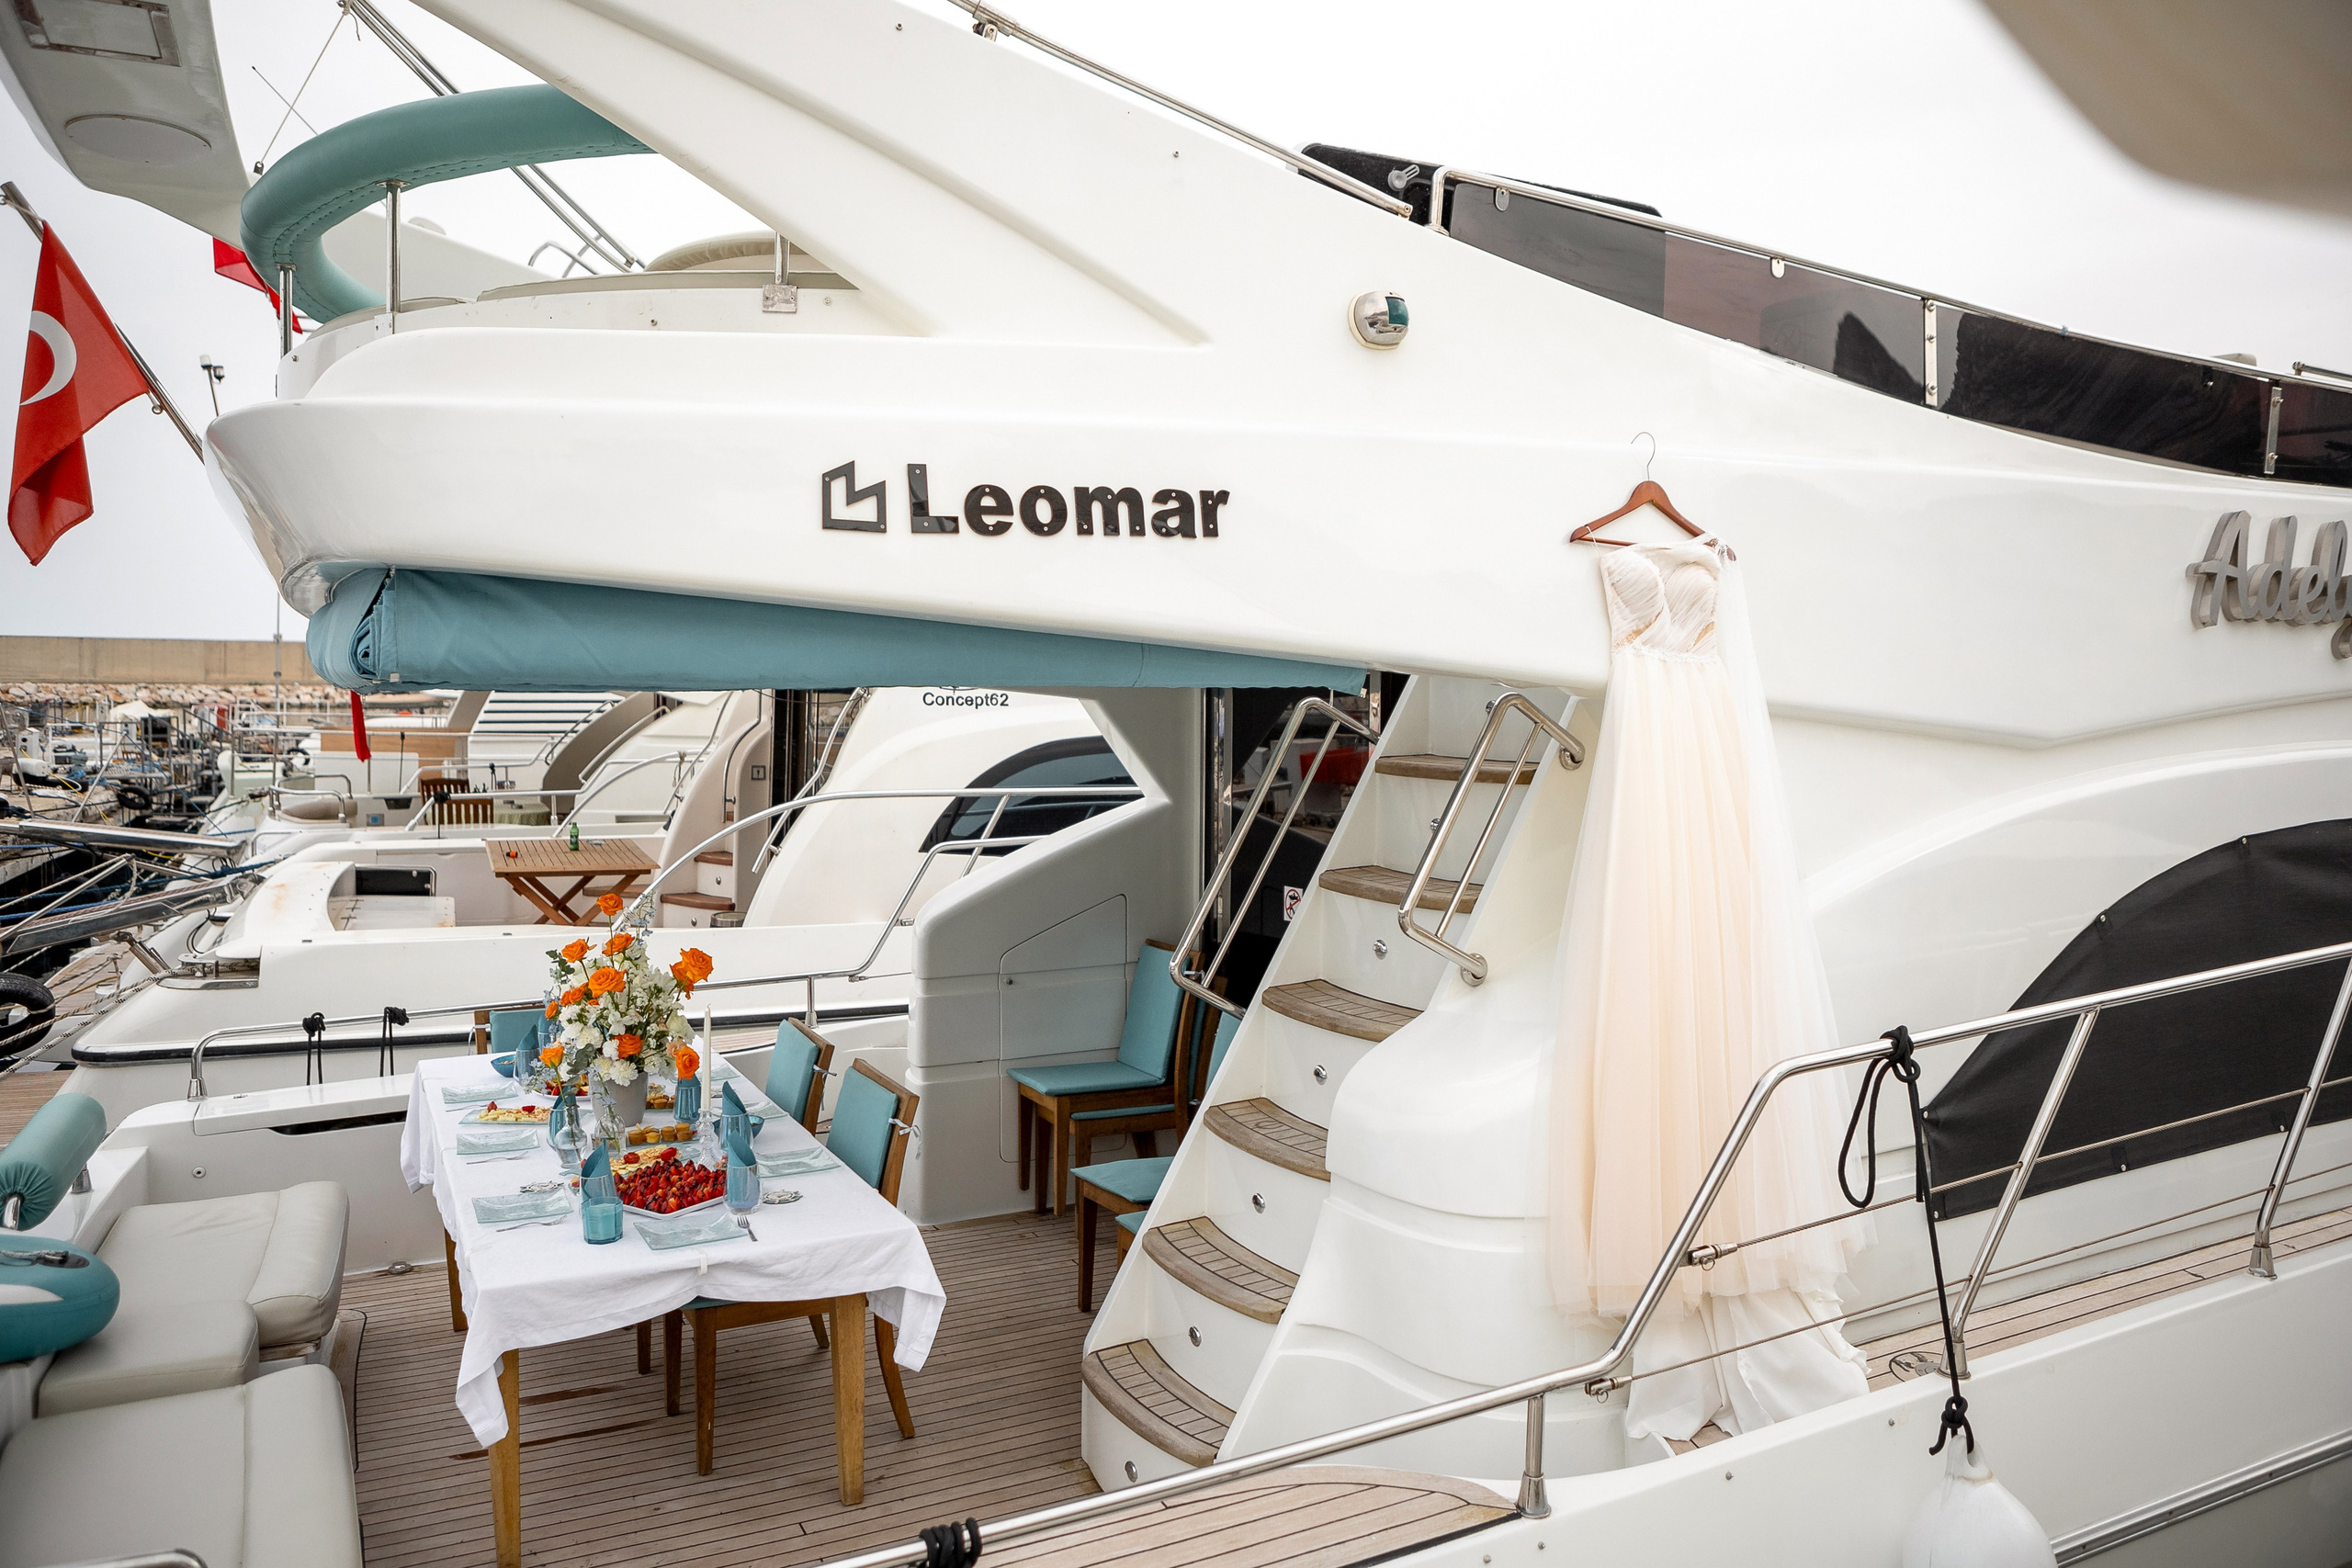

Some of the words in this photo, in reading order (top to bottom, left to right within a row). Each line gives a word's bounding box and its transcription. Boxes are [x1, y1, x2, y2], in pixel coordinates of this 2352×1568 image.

[907, 463, 1230, 539] Leomar
[2186, 510, 2352, 660] Adel
[922, 692, 1009, 709] Concept62
